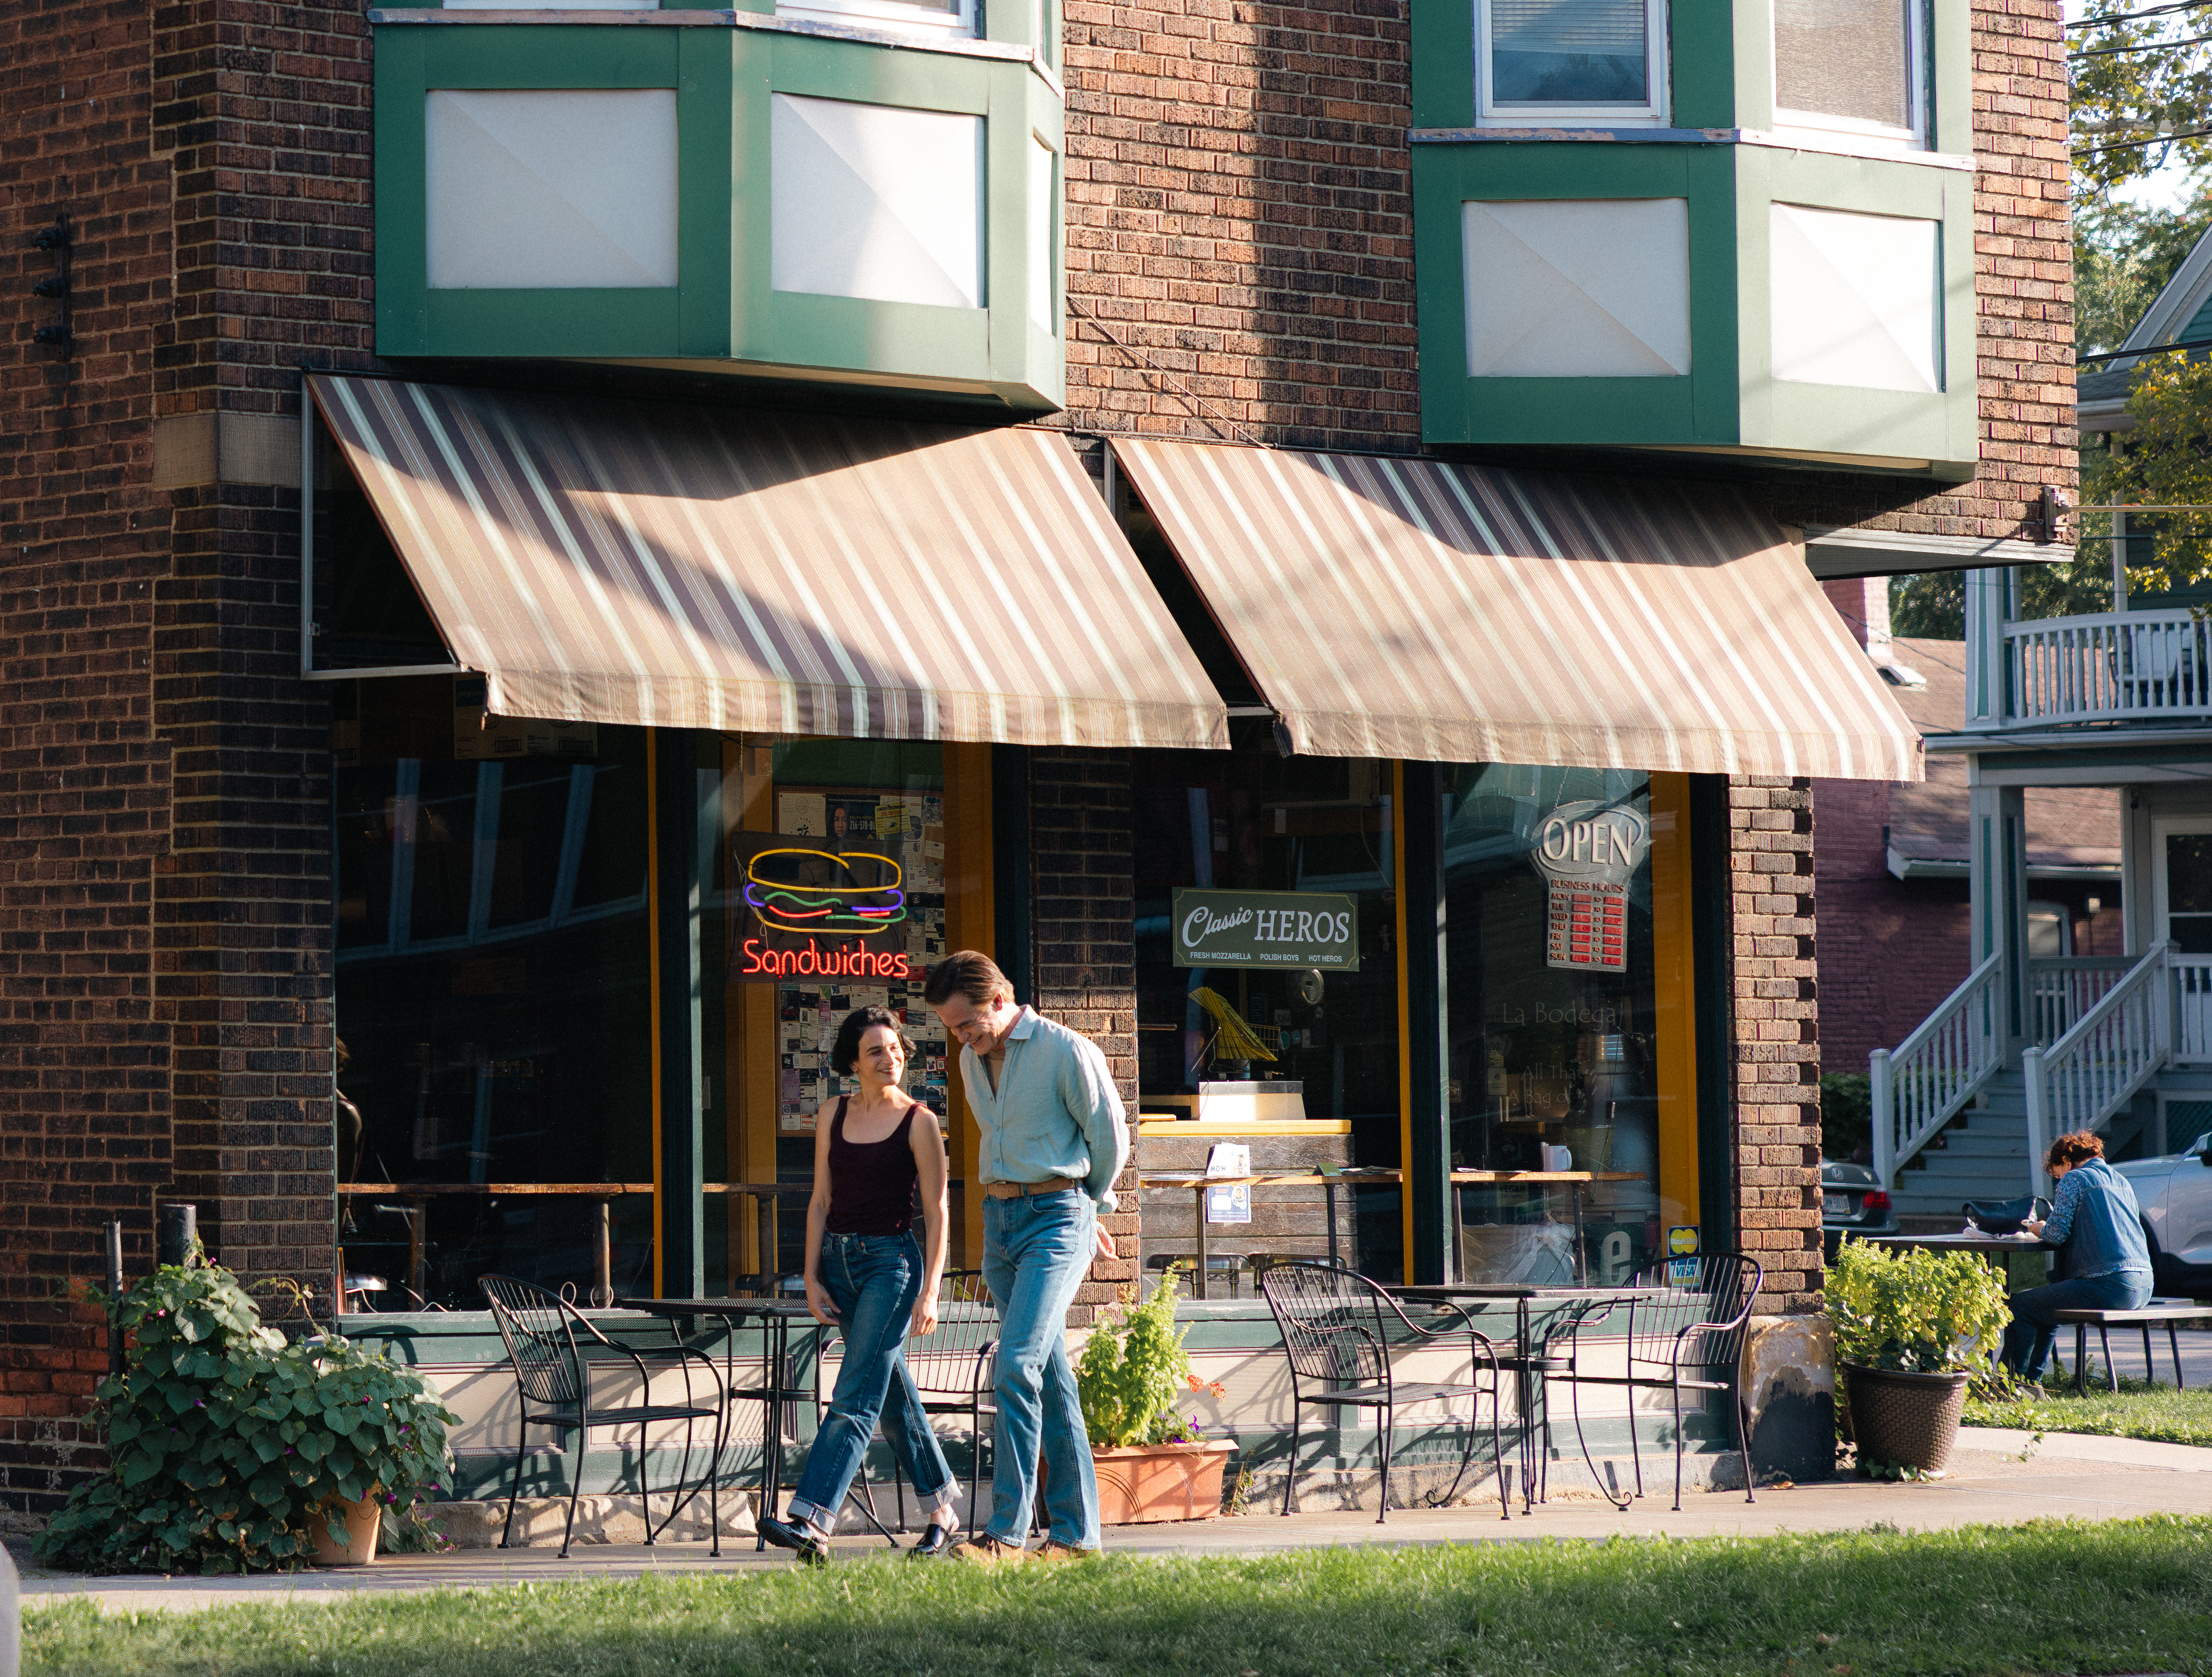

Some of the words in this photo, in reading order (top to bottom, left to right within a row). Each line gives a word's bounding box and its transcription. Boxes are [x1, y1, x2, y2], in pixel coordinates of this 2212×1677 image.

[1542, 818, 1632, 866] OPEN
[1551, 879, 1591, 890] BUSINESS
[1593, 882, 1625, 893] HOURS
[1182, 906, 1253, 947] Classic
[1255, 910, 1350, 944] HEROS
[743, 939, 909, 977] Sandwiches
[1211, 952, 1251, 960] MOZZARELLA
[1504, 1003, 1525, 1025] La
[1536, 1000, 1616, 1031] Bodega
[1521, 1062, 1542, 1080] All
[1549, 1062, 1582, 1080] That
[1508, 1089, 1519, 1104] A
[1526, 1090, 1551, 1108] Bag
[1499, 1184, 1526, 1193] VEGAN
[1676, 1266, 1694, 1276] VISA
